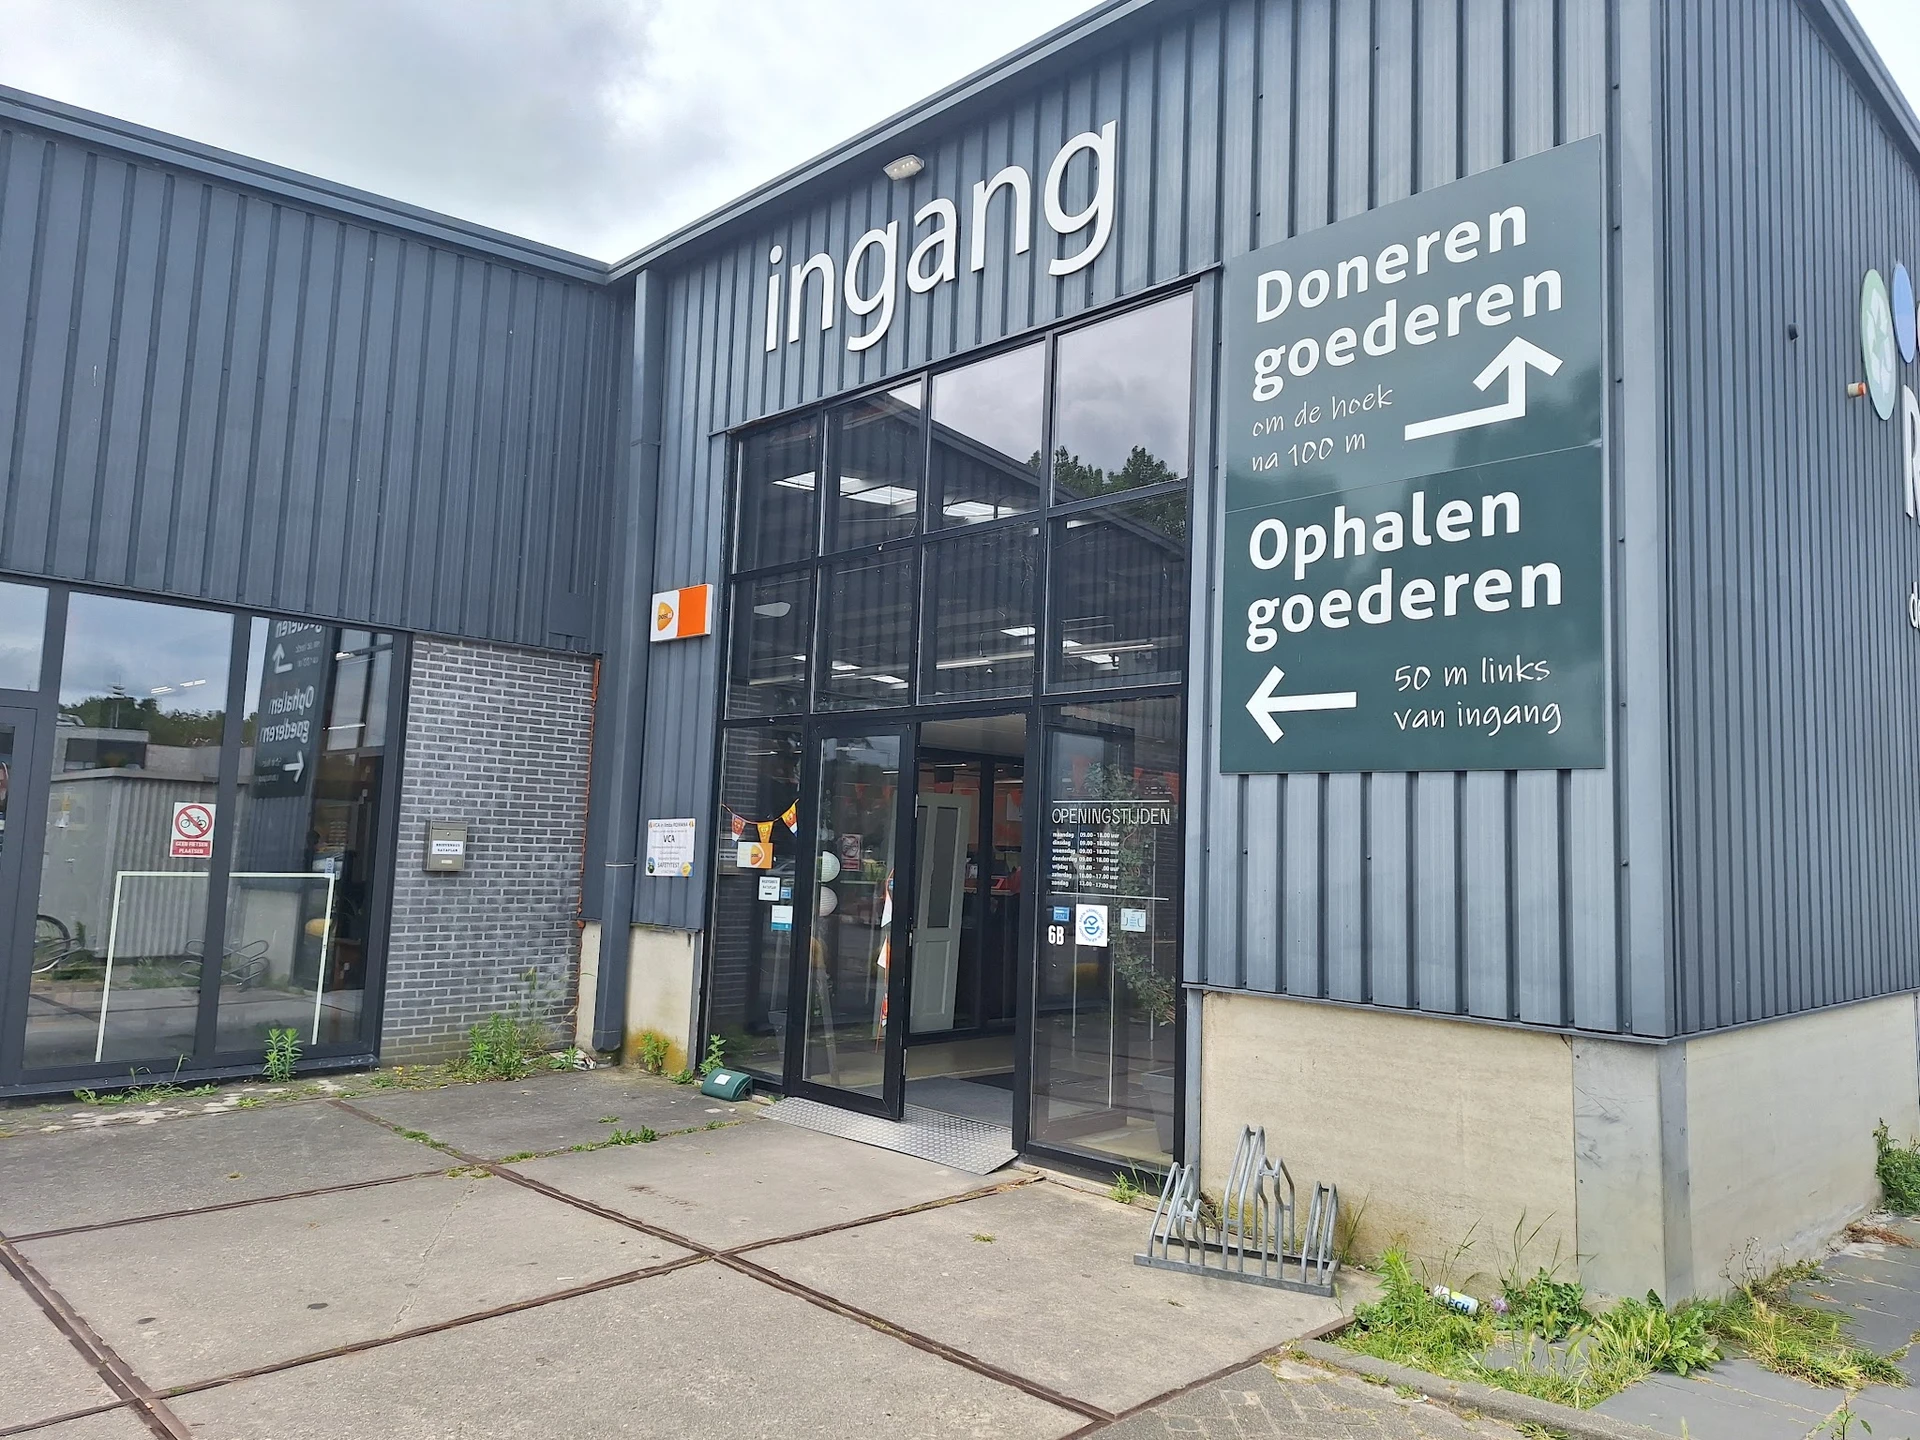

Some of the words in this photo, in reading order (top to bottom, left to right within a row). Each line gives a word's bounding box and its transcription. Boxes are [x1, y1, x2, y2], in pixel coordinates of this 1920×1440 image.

[765, 120, 1117, 352] ingang
[1256, 206, 1526, 323] Doneren
[1252, 270, 1562, 402] goederen
[1252, 415, 1284, 437] om
[1294, 401, 1322, 428] de
[1331, 383, 1394, 420] hoek
[1252, 452, 1279, 472] na
[1287, 436, 1335, 467] 100
[1345, 432, 1366, 454] m
[1249, 491, 1520, 581] Ophalen
[1246, 562, 1562, 652] goederen
[1394, 665, 1432, 692] 50
[1444, 666, 1468, 687] m
[1481, 654, 1551, 684] links
[1393, 708, 1445, 731] van
[1457, 700, 1562, 737] ingang
[1051, 808, 1170, 825] OPENINGSTIJDEN
[1051, 863, 1069, 871] vrijdag
[1048, 925, 1065, 945] 6B
